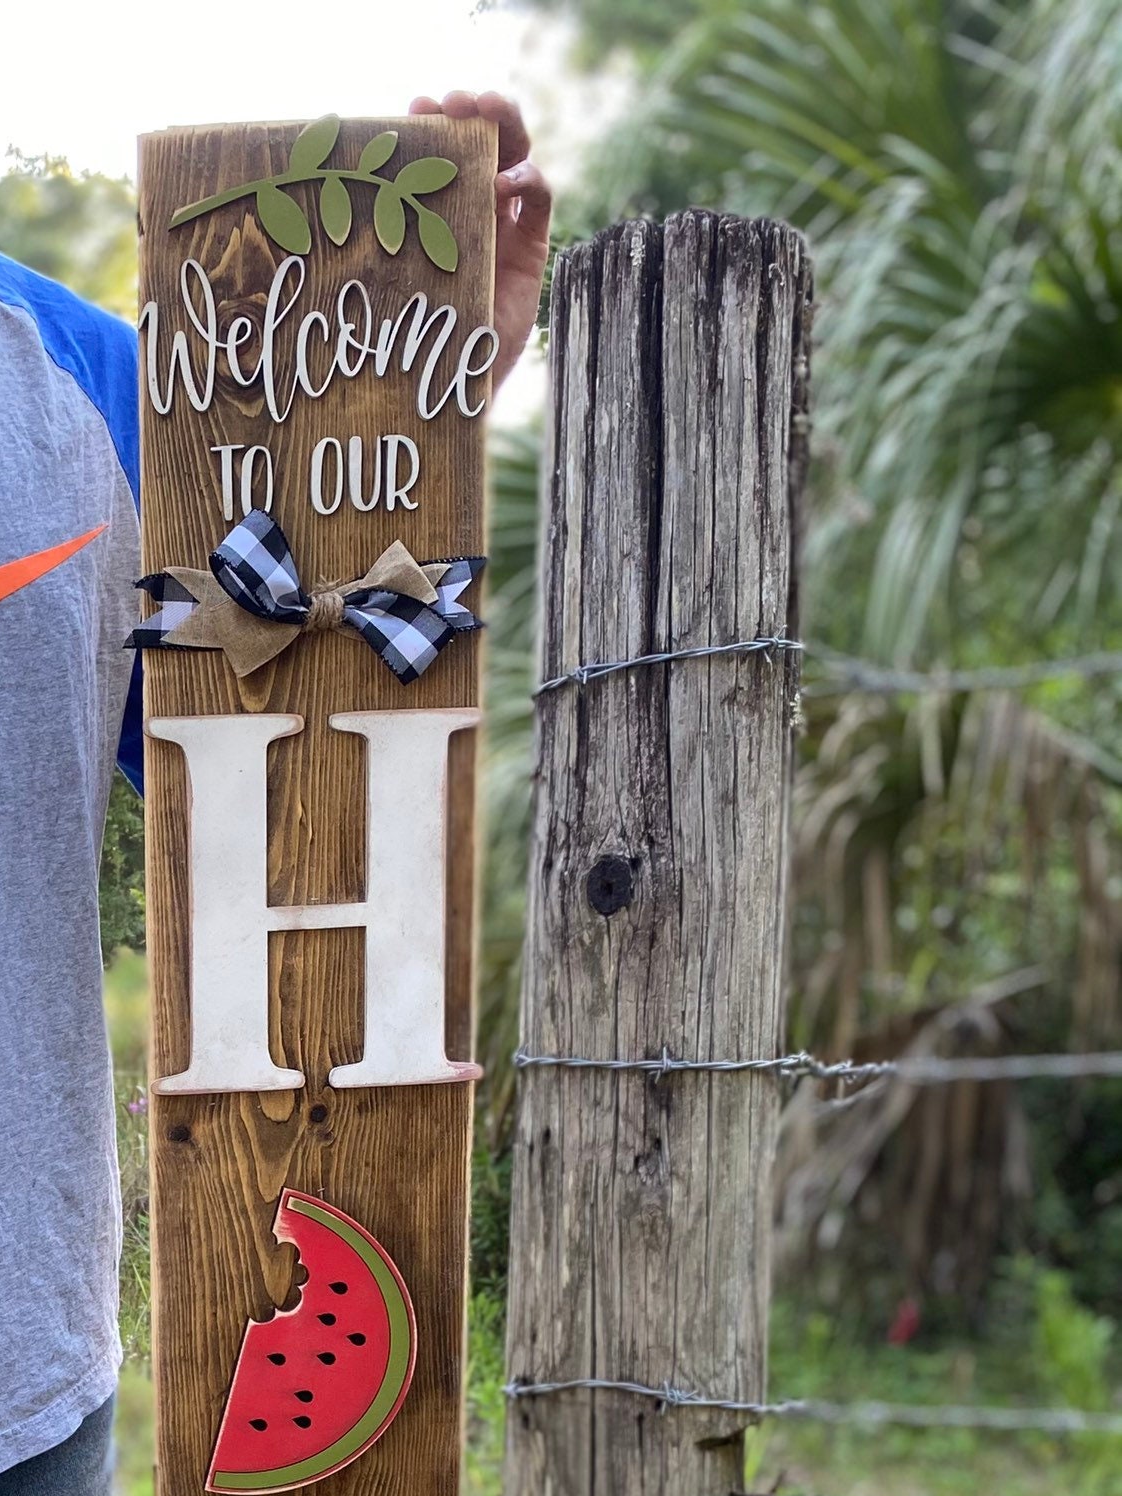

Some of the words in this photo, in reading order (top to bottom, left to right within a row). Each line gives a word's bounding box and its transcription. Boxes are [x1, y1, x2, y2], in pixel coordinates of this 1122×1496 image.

[140, 256, 499, 422] Welcome
[210, 444, 273, 521] TO
[311, 434, 420, 516] OUR
